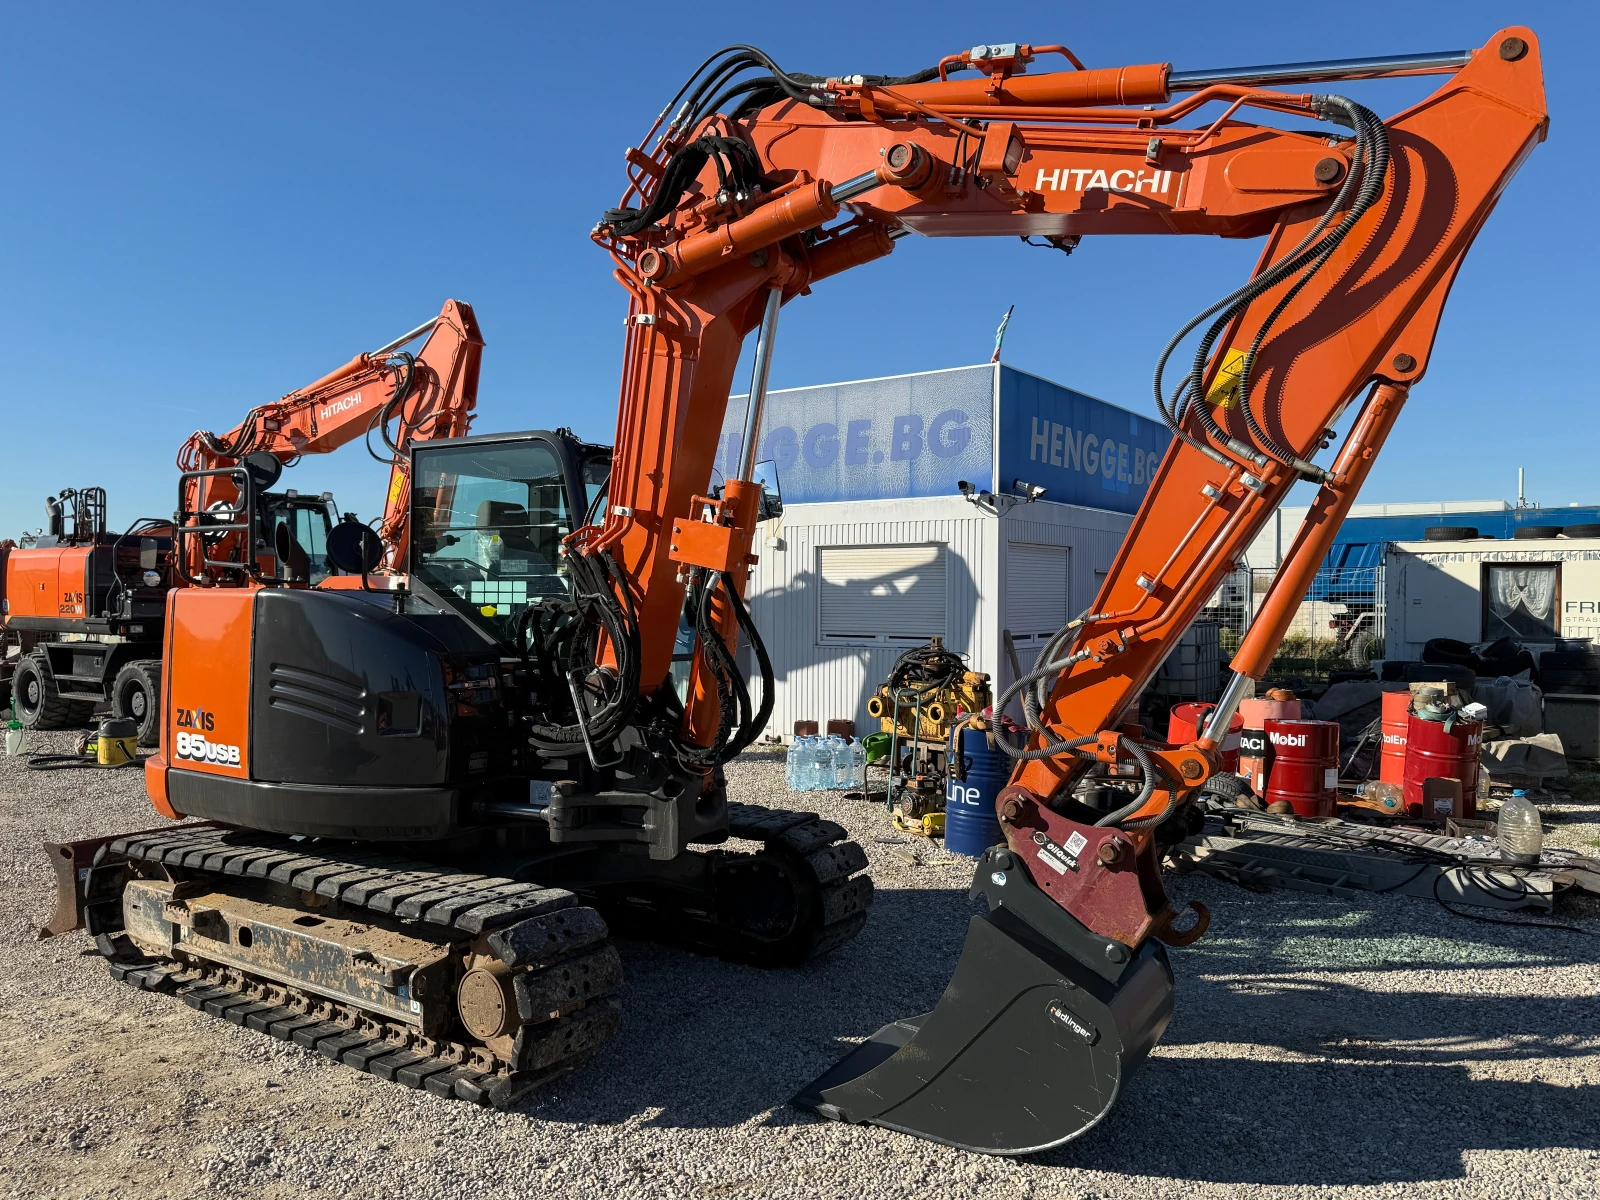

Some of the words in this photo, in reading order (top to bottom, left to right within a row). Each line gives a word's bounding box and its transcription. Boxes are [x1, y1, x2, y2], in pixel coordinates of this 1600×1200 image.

[1035, 168, 1172, 194] HITACHI
[320, 391, 362, 420] HITACHI
[1030, 416, 1159, 485] HENGGE.BG
[60, 604, 83, 615] 220W
[64, 591, 83, 603] ZAXIS
[1565, 601, 1600, 613] FR
[176, 706, 215, 732] ZAXIS
[176, 731, 240, 765] 85USB
[1269, 731, 1306, 747] Mobil
[1467, 734, 1482, 746] Mo
[1046, 843, 1077, 868] OilQuick
